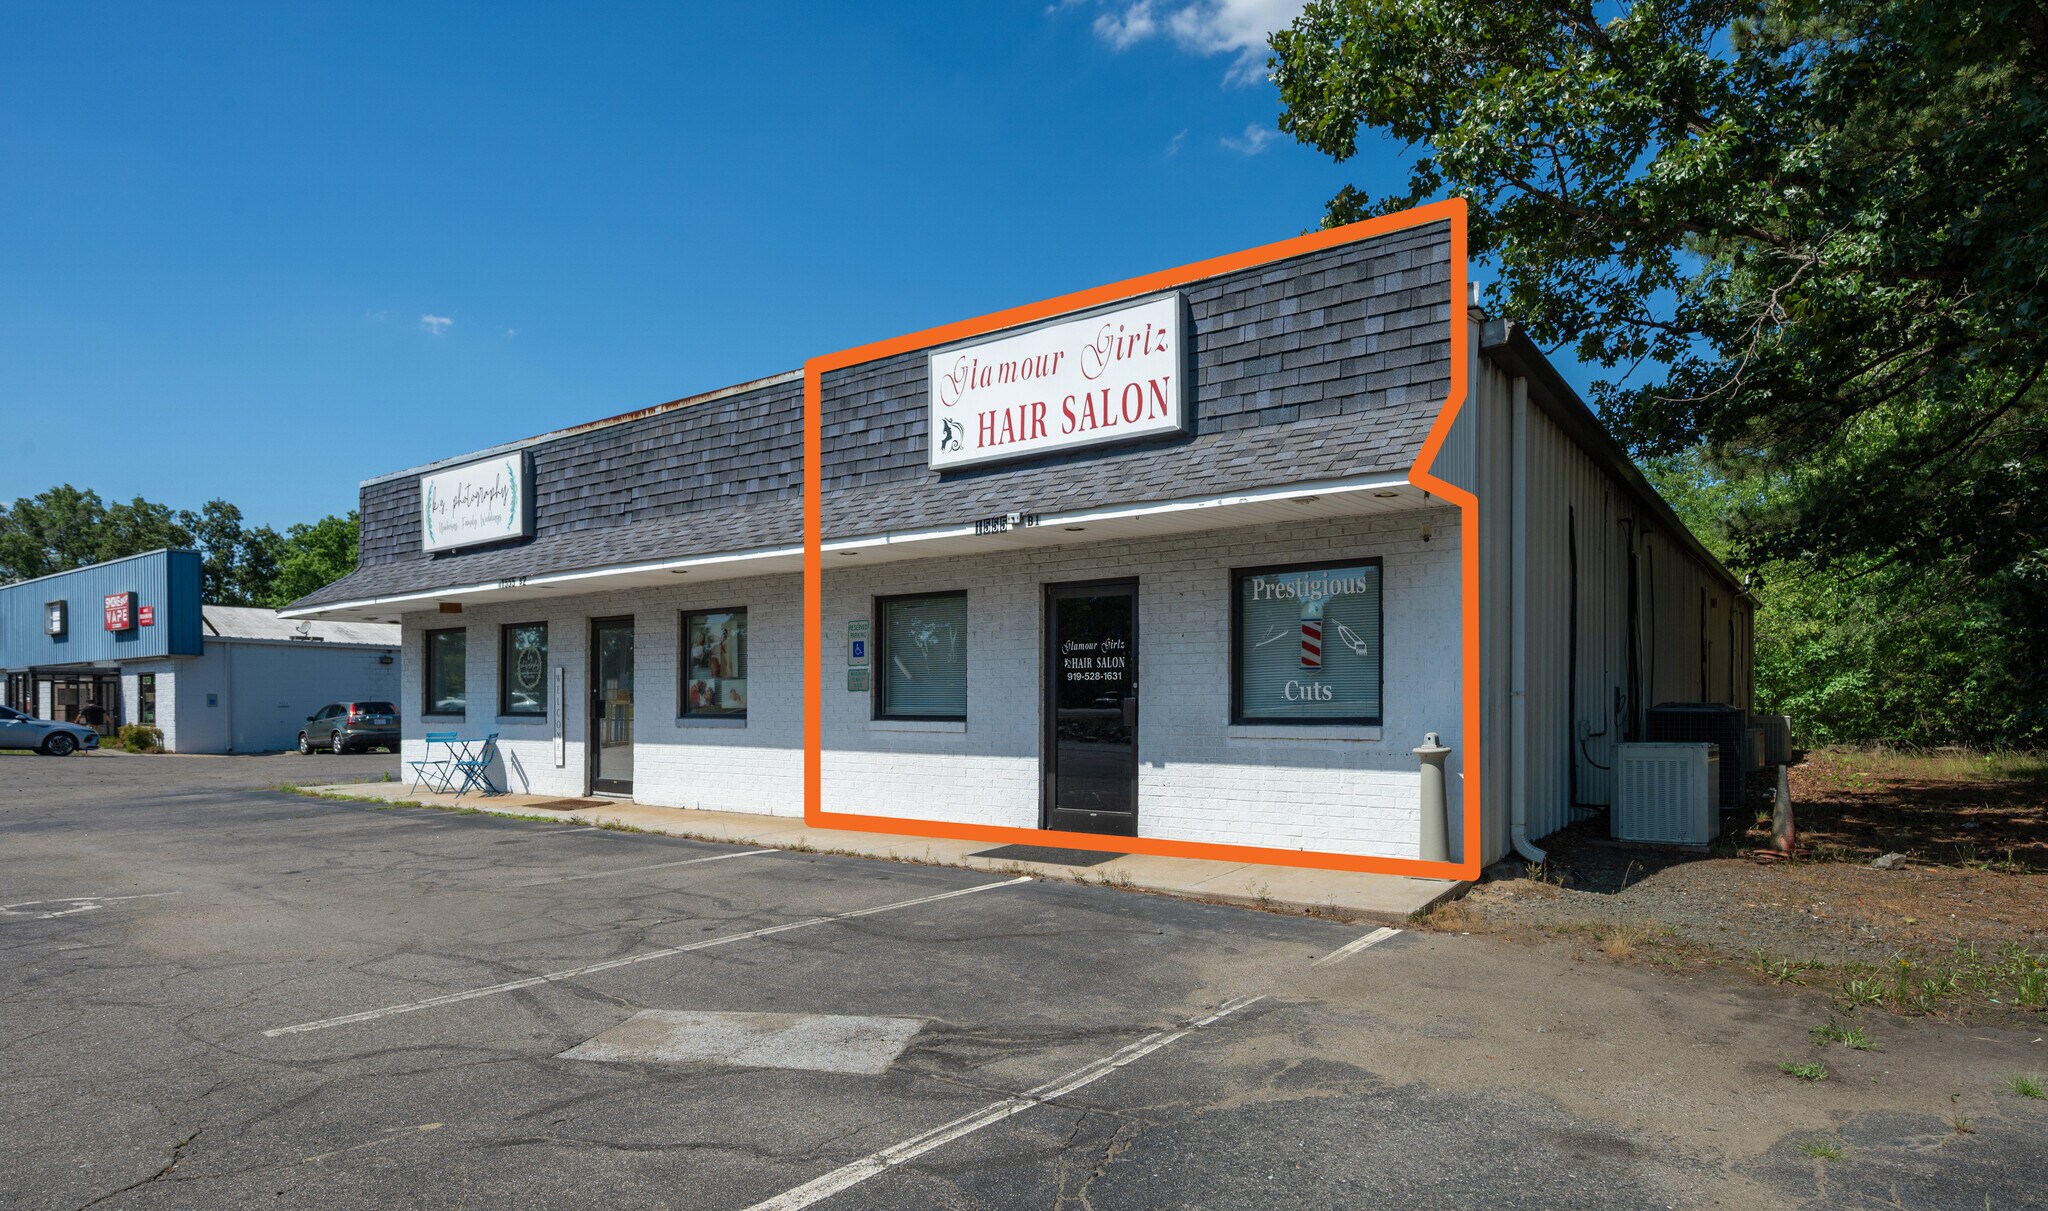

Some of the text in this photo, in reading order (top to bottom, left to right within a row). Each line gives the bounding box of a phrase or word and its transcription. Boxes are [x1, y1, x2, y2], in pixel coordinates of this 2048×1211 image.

[940, 323, 1168, 407] Glamour Girlz
[977, 376, 1170, 448] HAIR SALON
[452, 472, 509, 519] photography
[976, 515, 1039, 535] 1555 B1
[1252, 572, 1367, 600] Prestigious
[106, 609, 128, 623] VAPE
[1062, 638, 1125, 655] Glamour Girlz
[1072, 656, 1125, 669] HAIR SALON
[1067, 671, 1122, 681] 919-528-1631
[1284, 680, 1333, 701] Cuts
